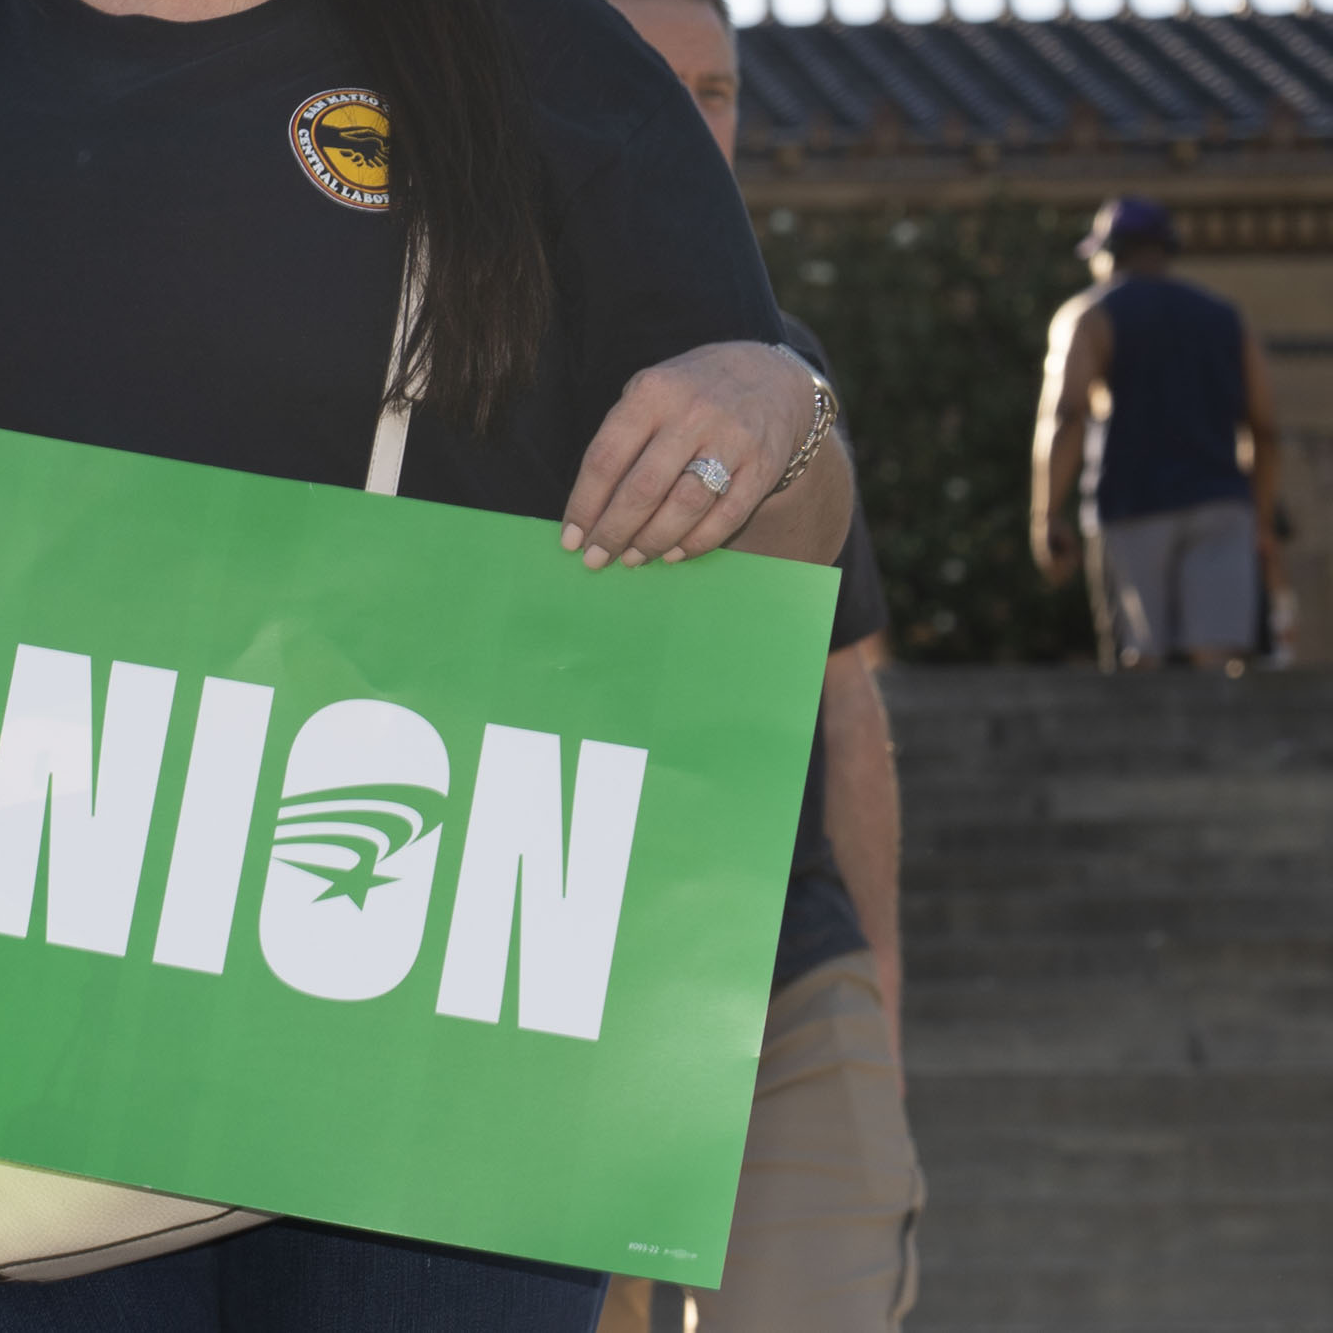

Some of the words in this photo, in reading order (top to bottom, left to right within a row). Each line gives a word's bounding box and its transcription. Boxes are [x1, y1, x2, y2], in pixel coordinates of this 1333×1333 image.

[303, 100, 328, 120] SAN
[326, 93, 379, 106] MATEO
[298, 128, 339, 192] CENTRAL
